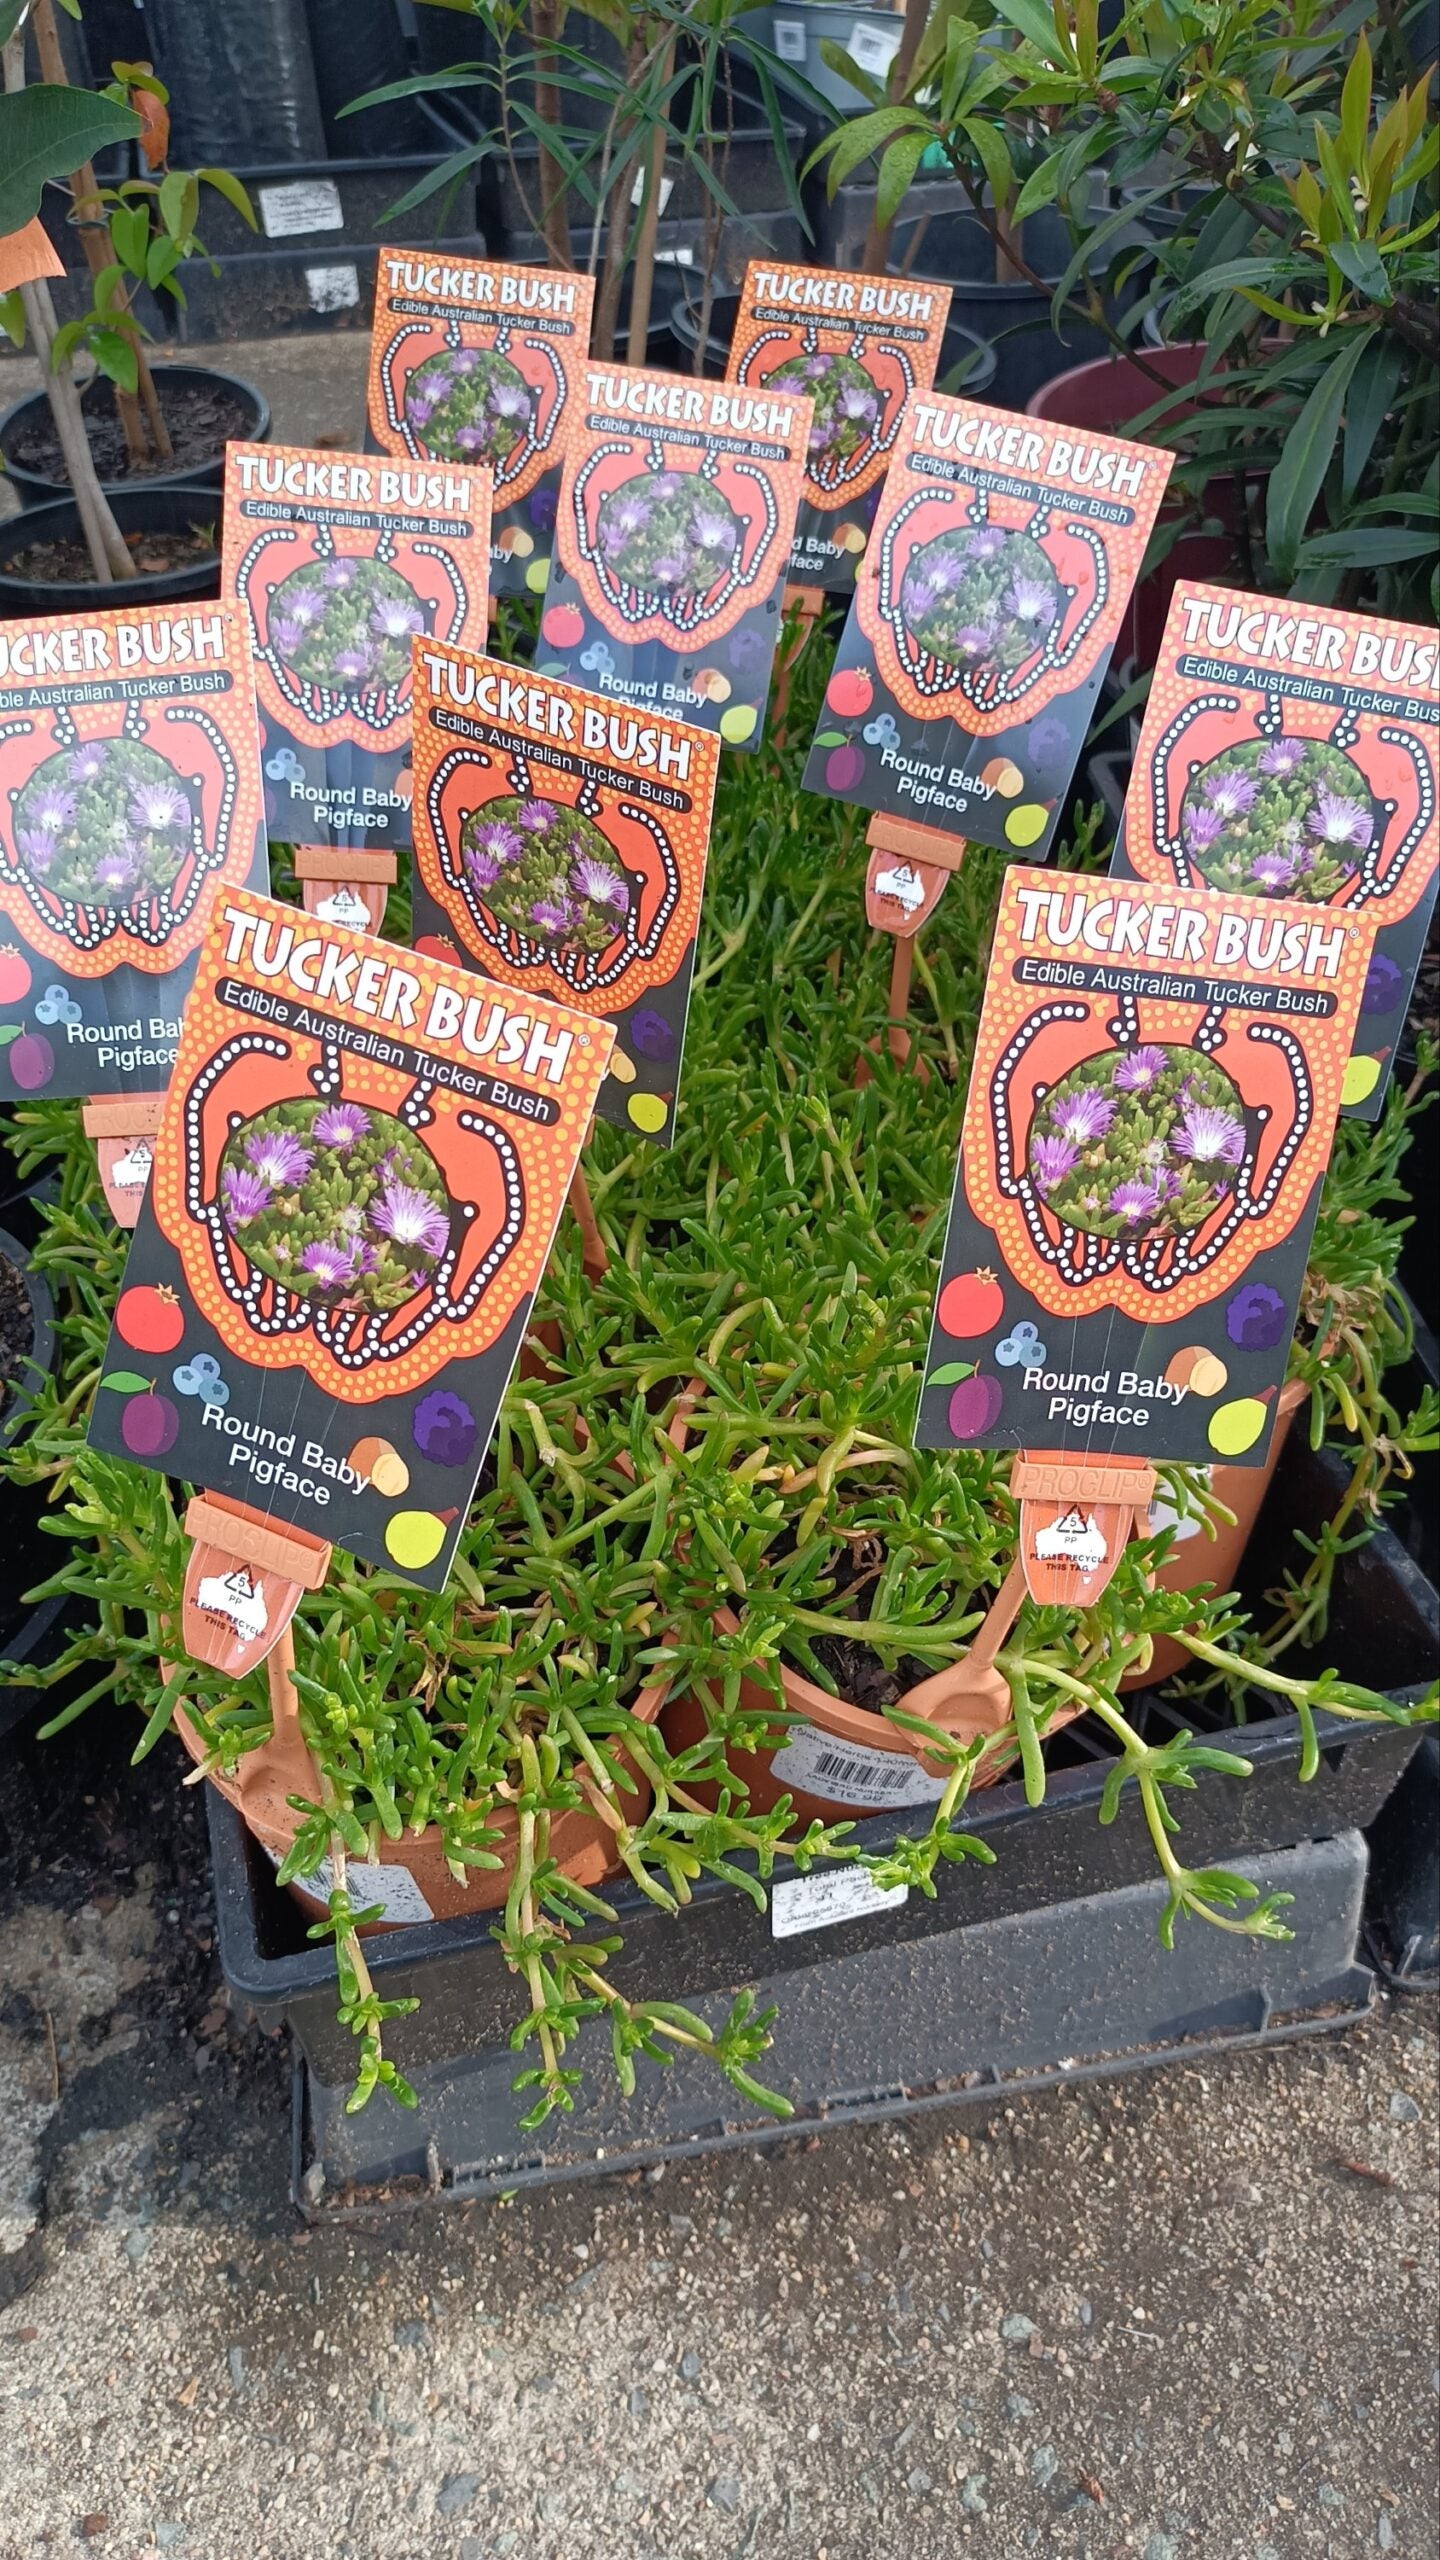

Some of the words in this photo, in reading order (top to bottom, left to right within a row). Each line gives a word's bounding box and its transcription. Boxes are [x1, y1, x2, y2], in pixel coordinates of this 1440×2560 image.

[386, 260, 495, 303] TUCKER
[500, 276, 576, 313] BUSH
[754, 272, 855, 311] TUCKER
[859, 287, 932, 321] BUSH
[392, 299, 429, 315] Edible
[431, 305, 492, 323] Australian
[497, 313, 536, 329] Tucker
[539, 320, 570, 335] Bush
[755, 308, 790, 322] Edible
[791, 313, 850, 331] Australian
[853, 321, 890, 337] Tucker
[893, 326, 924, 341] Bush
[586, 373, 705, 424] TUCKER
[710, 394, 793, 437] BUSH
[590, 416, 630, 435] Edible
[632, 424, 700, 446] Australian
[704, 435, 749, 453] Tucker
[750, 443, 785, 460] Bush
[913, 404, 1046, 473] TUCKER
[1046, 438, 1146, 498] BUSH
[235, 455, 373, 503] TUCKER
[379, 468, 470, 512] BUSH
[910, 454, 956, 478] Edible
[958, 466, 1032, 498] Australian
[1036, 485, 1086, 513] Tucker
[1088, 499, 1128, 524] Bush
[246, 501, 291, 519] Edible
[295, 506, 371, 527] Australian
[376, 514, 425, 532] Tucker
[429, 519, 467, 537] Bush
[490, 544, 512, 564] by
[791, 552, 824, 571] face
[806, 537, 846, 559] Baby
[0, 627, 112, 679] CKER
[116, 615, 225, 668] BUSH
[1182, 597, 1346, 672] TUCKER
[0, 690, 23, 709] ble
[28, 682, 114, 706] Australian
[118, 678, 175, 697] Tucker
[180, 673, 225, 693] Bush
[599, 672, 658, 698] Round
[662, 683, 708, 709] Baby
[1183, 657, 1238, 682] Edible
[1242, 668, 1334, 702] Australian
[1341, 687, 1400, 715] Tucker
[1405, 702, 1440, 722] Bus
[422, 652, 577, 742] TUCKER
[582, 706, 693, 782] BUSH
[435, 710, 484, 741] Edible
[489, 729, 573, 772] Australian
[578, 758, 635, 793] Tucker
[639, 781, 684, 811] Bush
[880, 748, 945, 783] Round
[947, 768, 997, 802] Baby
[290, 781, 356, 805] Round
[362, 787, 413, 812] Baby
[896, 776, 968, 813] Pigface
[313, 805, 389, 829] Pigface
[1016, 887, 1208, 964] TUCKER
[1213, 913, 1346, 979] BUSH
[223, 905, 423, 1030] TUCKER
[424, 983, 576, 1085] BUSH
[1022, 959, 1086, 986] Edible
[1090, 968, 1197, 1000] Australian
[1204, 981, 1272, 1007] Tucker
[1277, 990, 1329, 1014] Bush
[66, 1019, 142, 1044] Round
[98, 1045, 178, 1072] Pigface
[224, 982, 290, 1022] Edible
[293, 1009, 405, 1065] Australian
[414, 1050, 487, 1097] Tucker
[490, 1083, 550, 1121] Bush
[1022, 1367, 1110, 1394] Round
[1117, 1371, 1190, 1406] Baby
[1048, 1397, 1150, 1427] Pigface
[201, 1402, 297, 1458] Round
[301, 1441, 371, 1496] Baby
[228, 1443, 331, 1505] Pigface
[1070, 1517, 1077, 1527] 5
[1030, 1553, 1065, 1561] PLEASE
[1066, 1554, 1109, 1564] RECYCLE
[1046, 1563, 1067, 1571] THIS
[1070, 1563, 1088, 1572] TAG
[229, 1595, 242, 1604] PP
[238, 1577, 246, 1587] 5
[190, 1597, 227, 1618] PLEASE
[226, 1613, 266, 1639] RECYCLE
[205, 1615, 226, 1630] THIS
[228, 1626, 246, 1640] TAG
